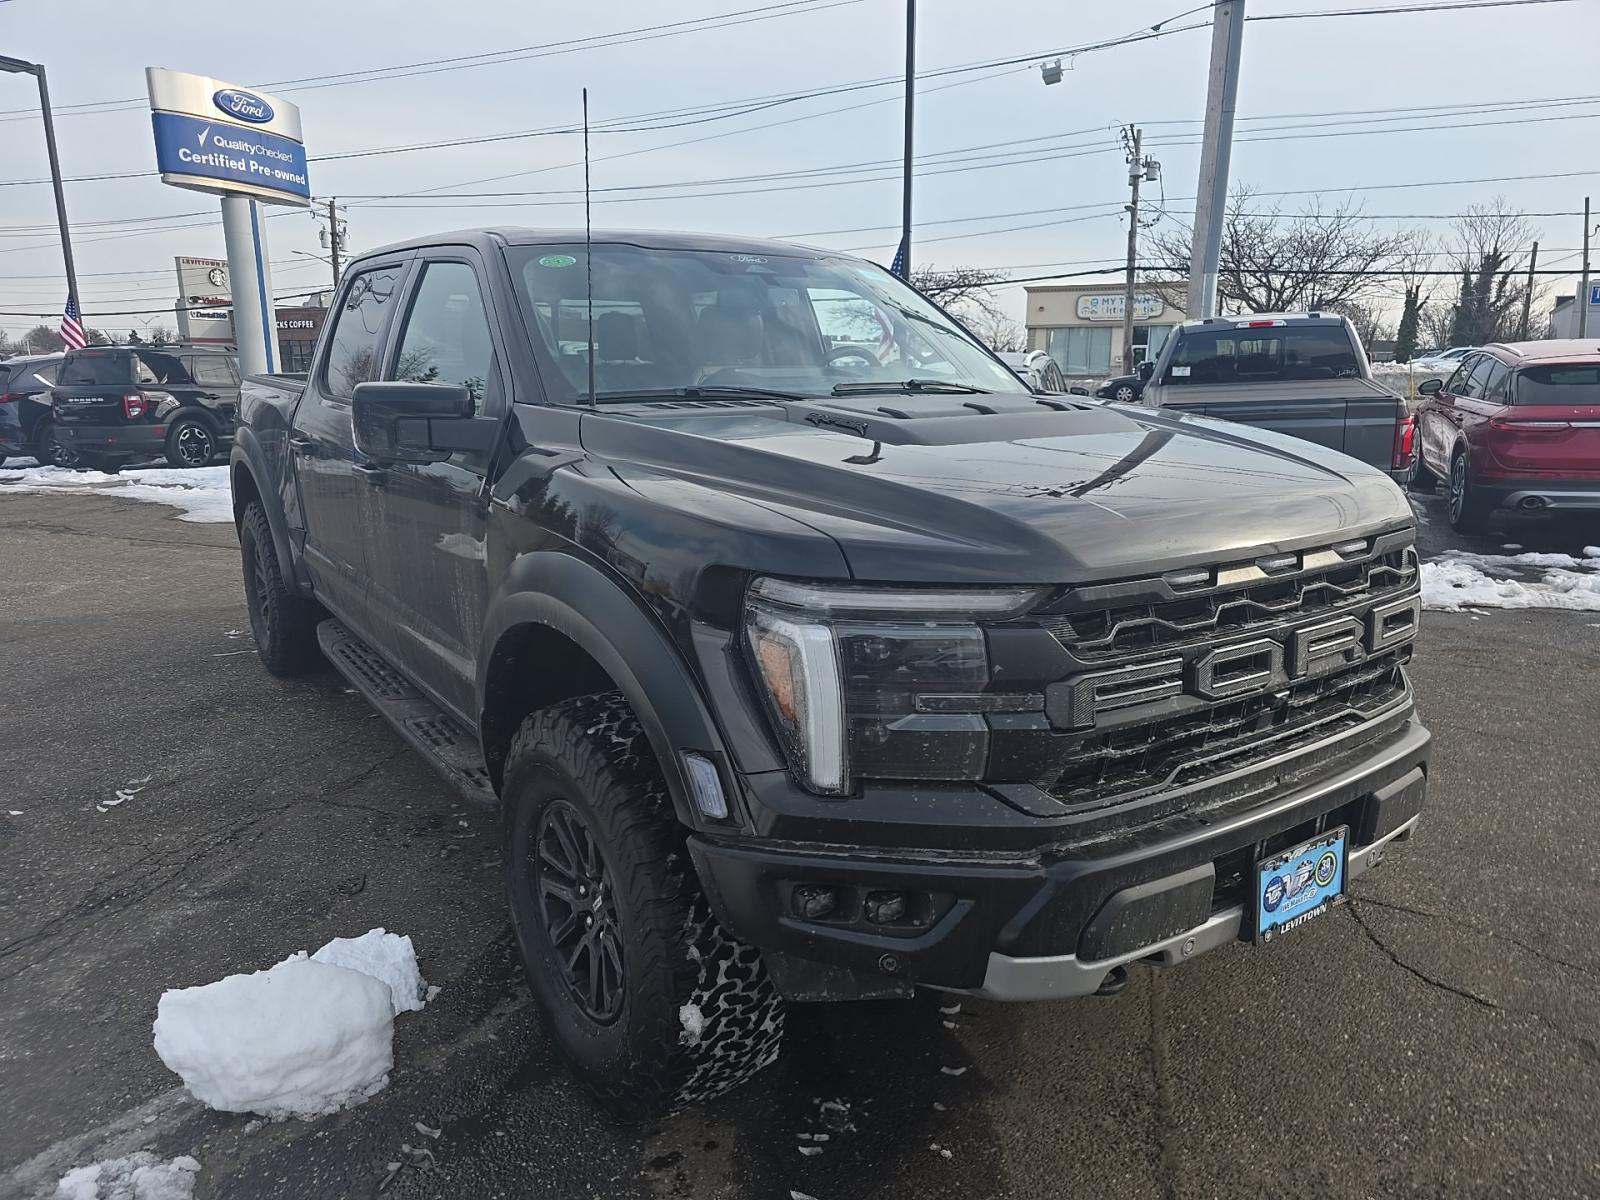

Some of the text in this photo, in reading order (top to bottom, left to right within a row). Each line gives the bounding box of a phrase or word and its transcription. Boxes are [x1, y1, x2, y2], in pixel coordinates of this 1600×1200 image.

[231, 94, 265, 118] Ford
[178, 148, 306, 185] Certified Pre-owned
[1102, 297, 1117, 305] MY
[289, 320, 314, 329] COFFEE
[1049, 597, 1421, 733] FORD
[1280, 903, 1328, 935] LEVITTOWN
